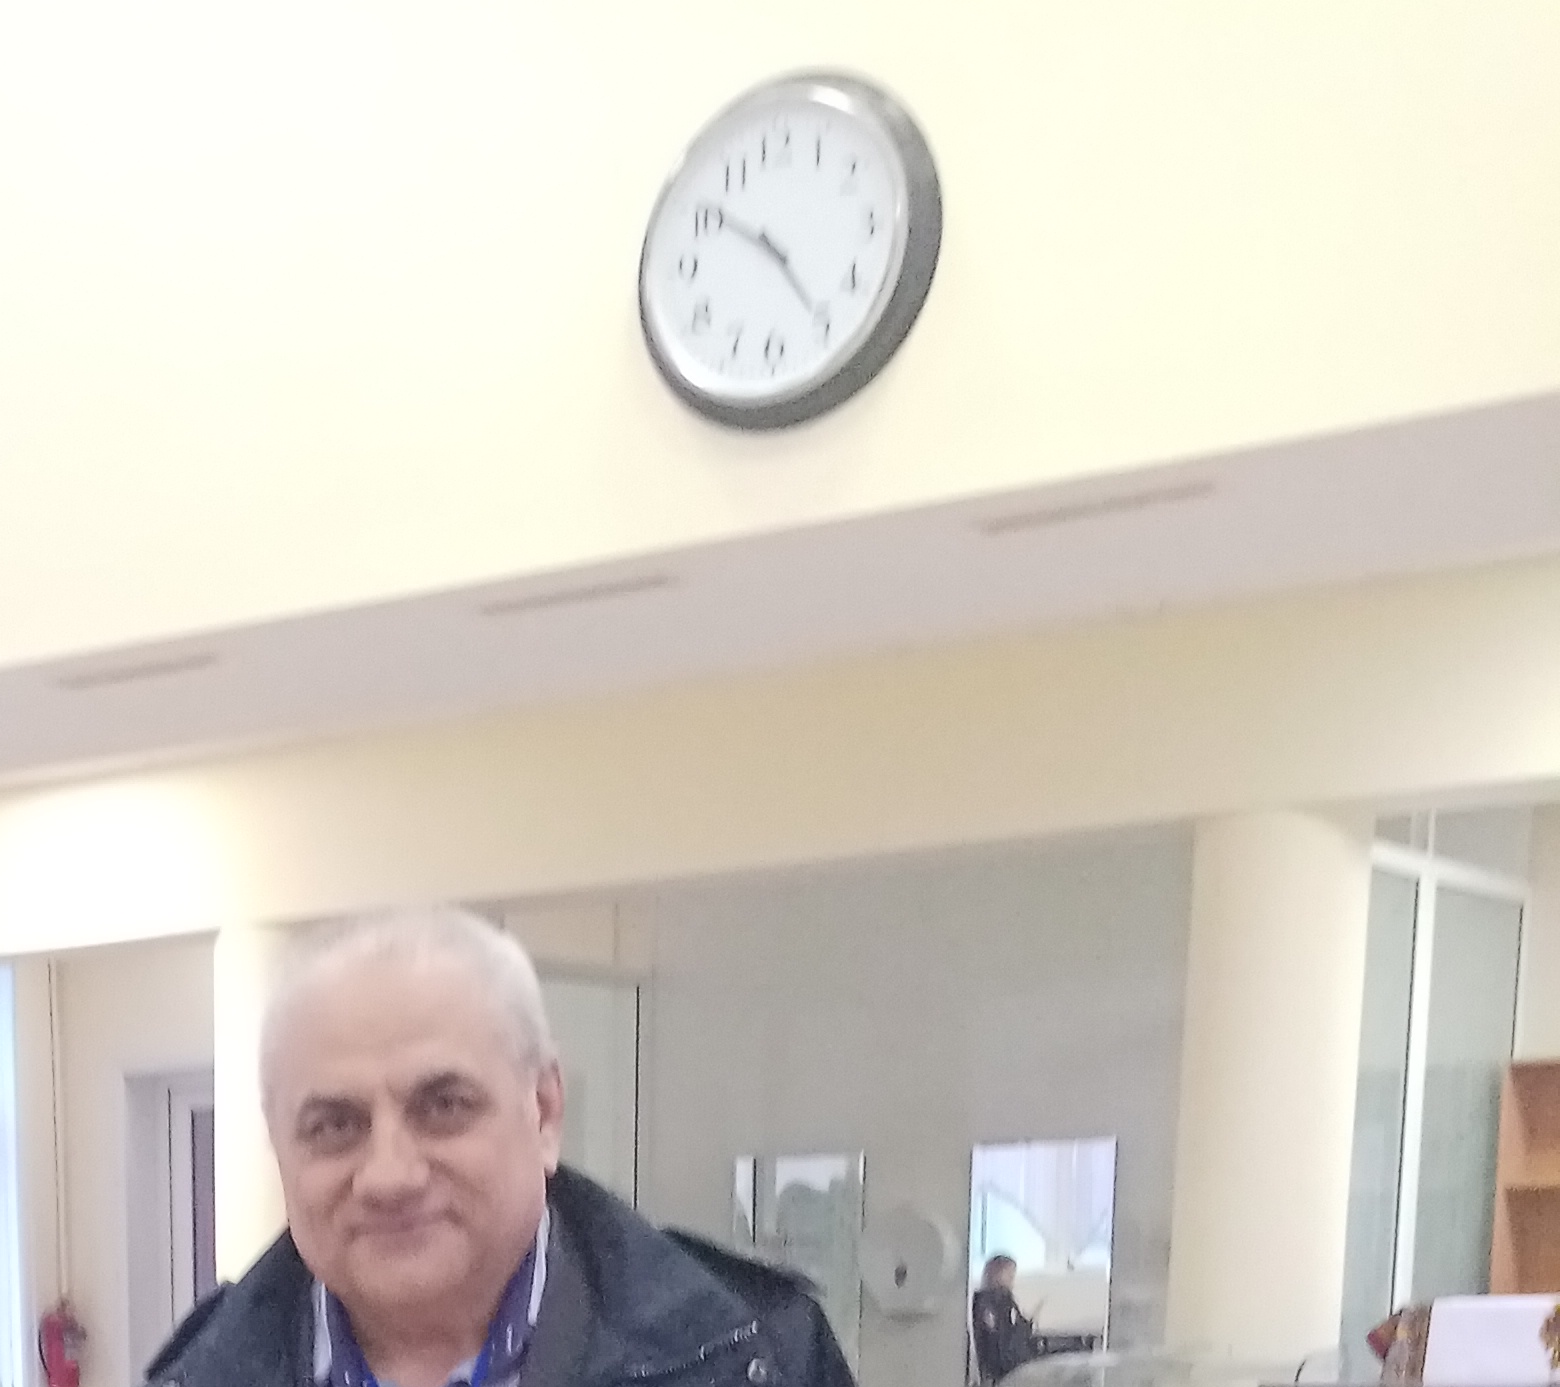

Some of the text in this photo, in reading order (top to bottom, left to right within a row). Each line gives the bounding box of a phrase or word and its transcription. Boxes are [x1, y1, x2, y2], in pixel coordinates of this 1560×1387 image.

[759, 129, 793, 170] 12
[723, 155, 748, 194] 11
[693, 203, 726, 240] 10
